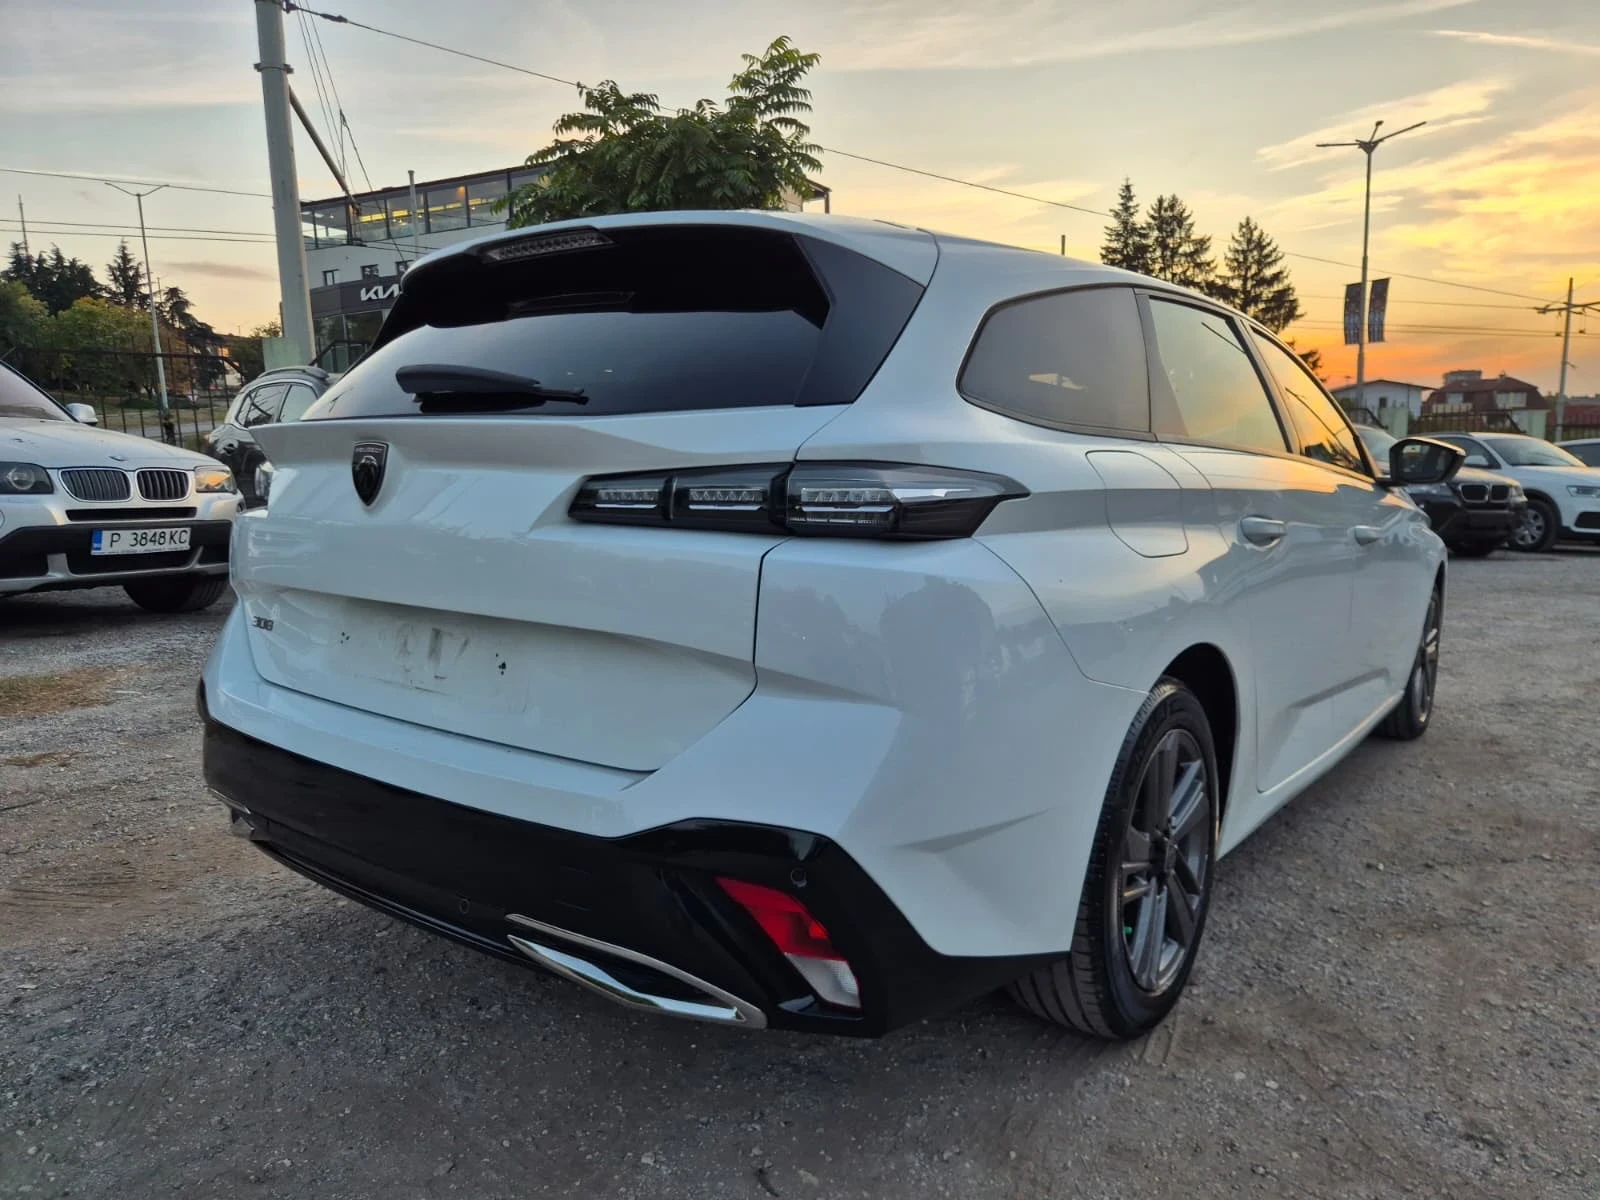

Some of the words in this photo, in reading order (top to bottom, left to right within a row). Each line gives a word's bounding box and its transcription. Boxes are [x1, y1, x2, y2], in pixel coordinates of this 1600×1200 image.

[360, 284, 400, 301] KIA
[110, 533, 121, 548] P
[252, 615, 274, 631] 308
